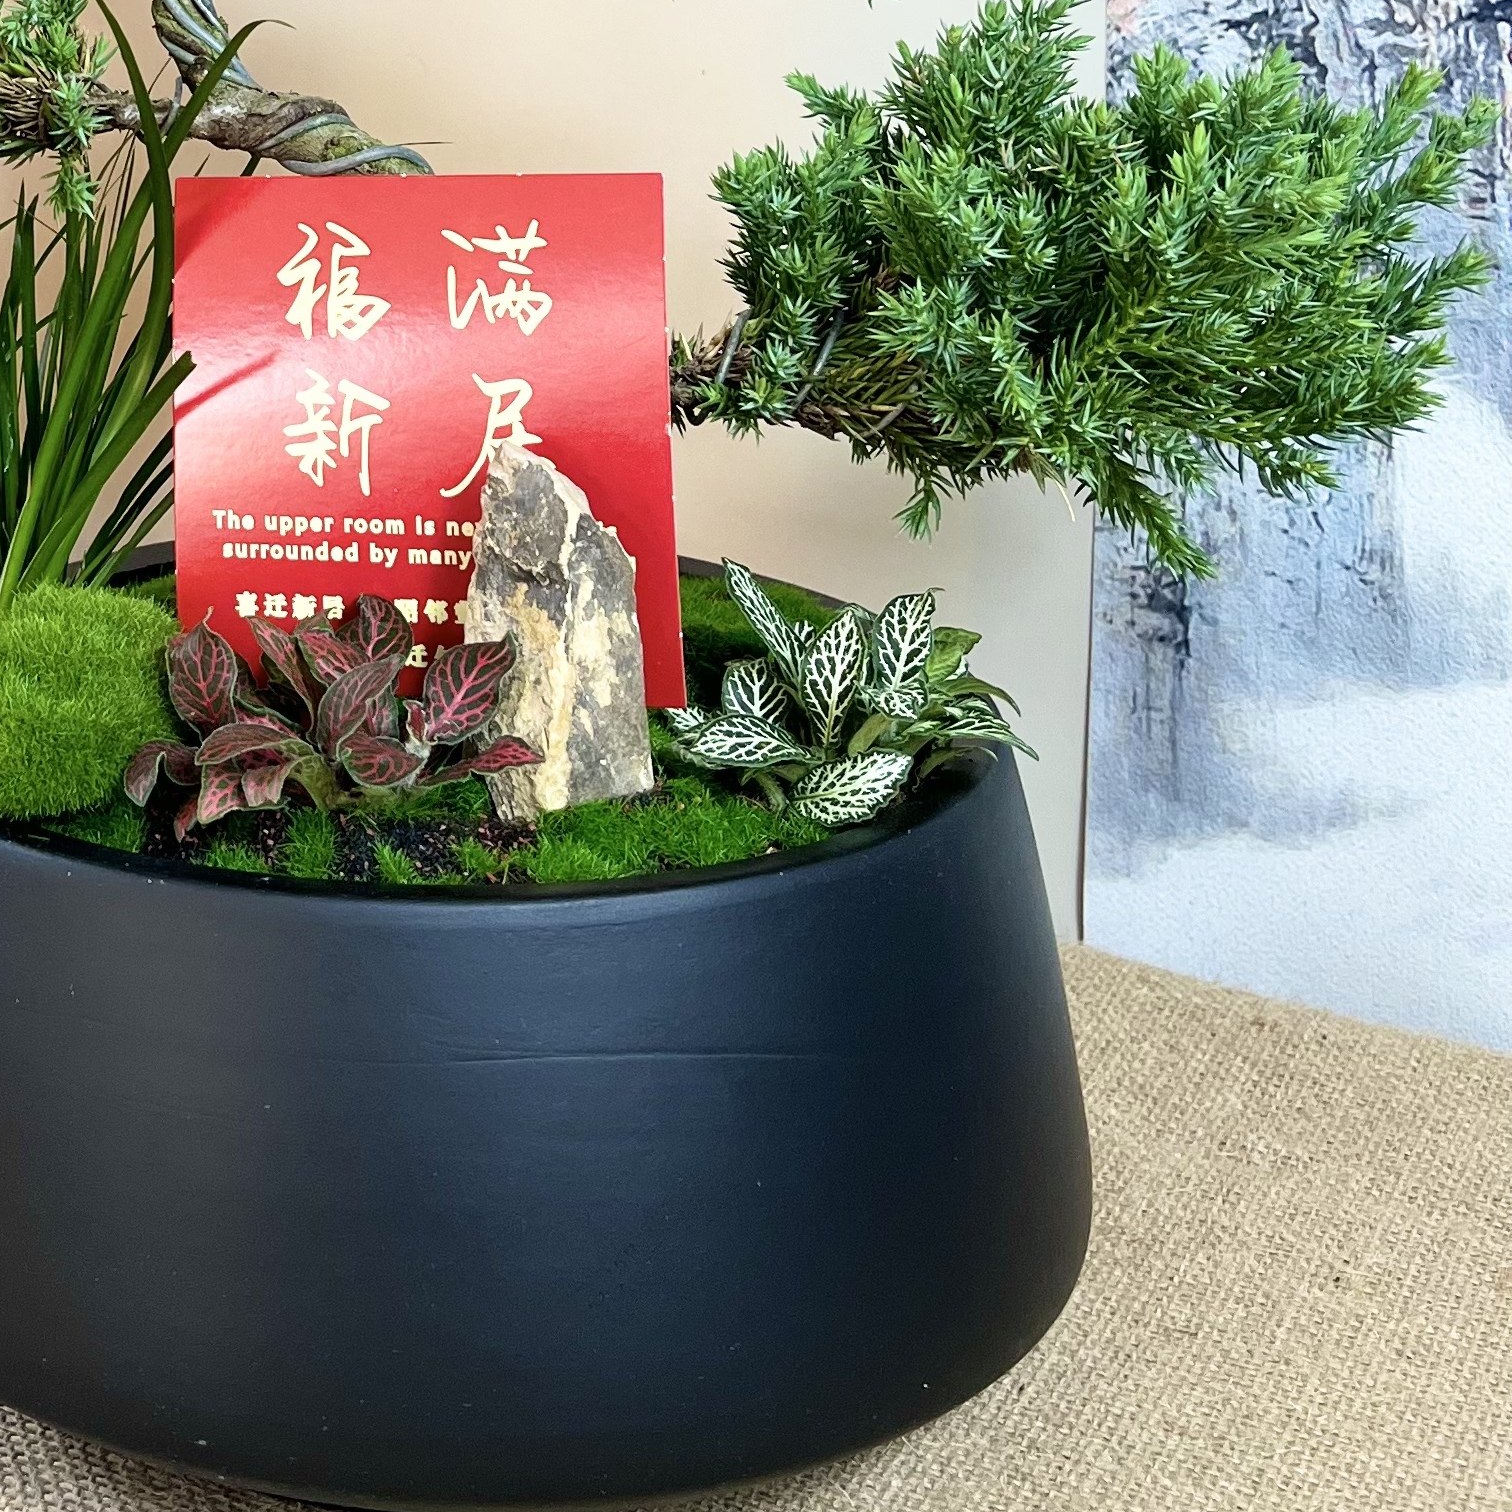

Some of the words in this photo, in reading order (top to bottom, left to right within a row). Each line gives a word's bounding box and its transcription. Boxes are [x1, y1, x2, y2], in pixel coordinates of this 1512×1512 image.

[211, 508, 255, 531] The
[264, 513, 334, 536] upper
[343, 517, 405, 535] room
[446, 520, 481, 537] ne
[222, 541, 359, 563] surrounded
[369, 542, 398, 568] by
[407, 548, 473, 570] many
